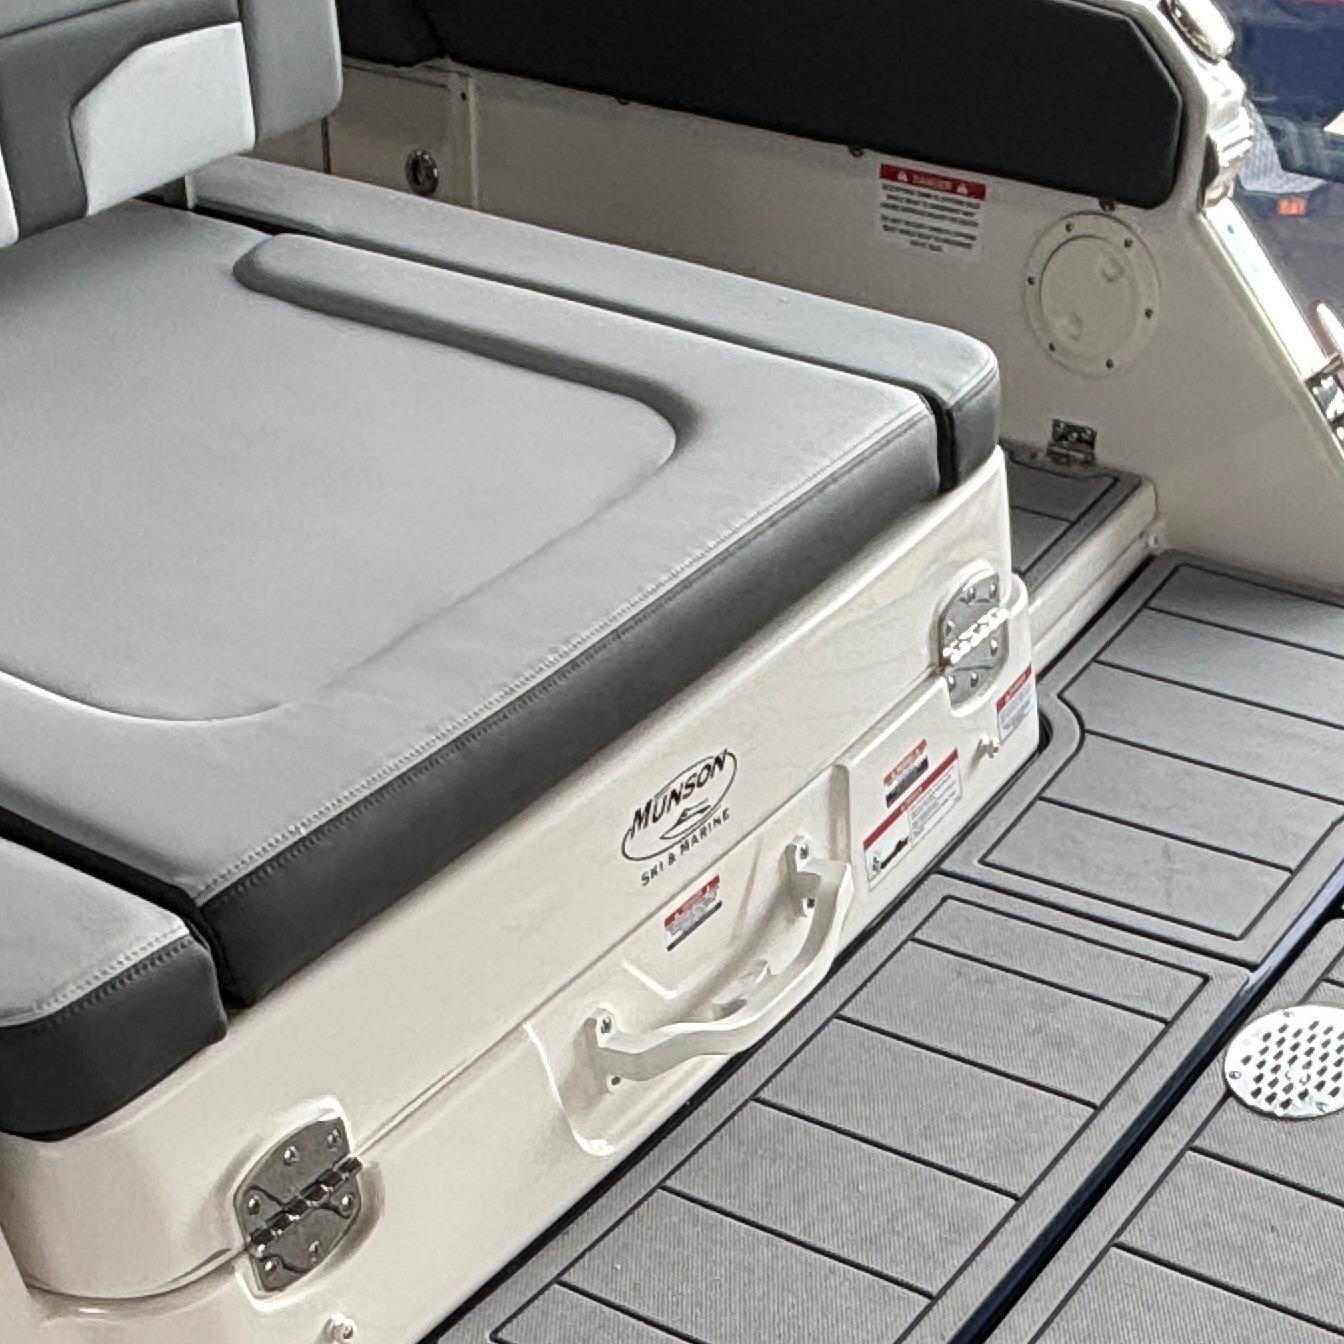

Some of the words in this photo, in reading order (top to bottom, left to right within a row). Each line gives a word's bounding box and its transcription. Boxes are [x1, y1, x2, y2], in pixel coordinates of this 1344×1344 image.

[629, 748, 728, 840] MUNSON
[641, 860, 664, 887] SKI
[680, 807, 730, 856] MARINE
